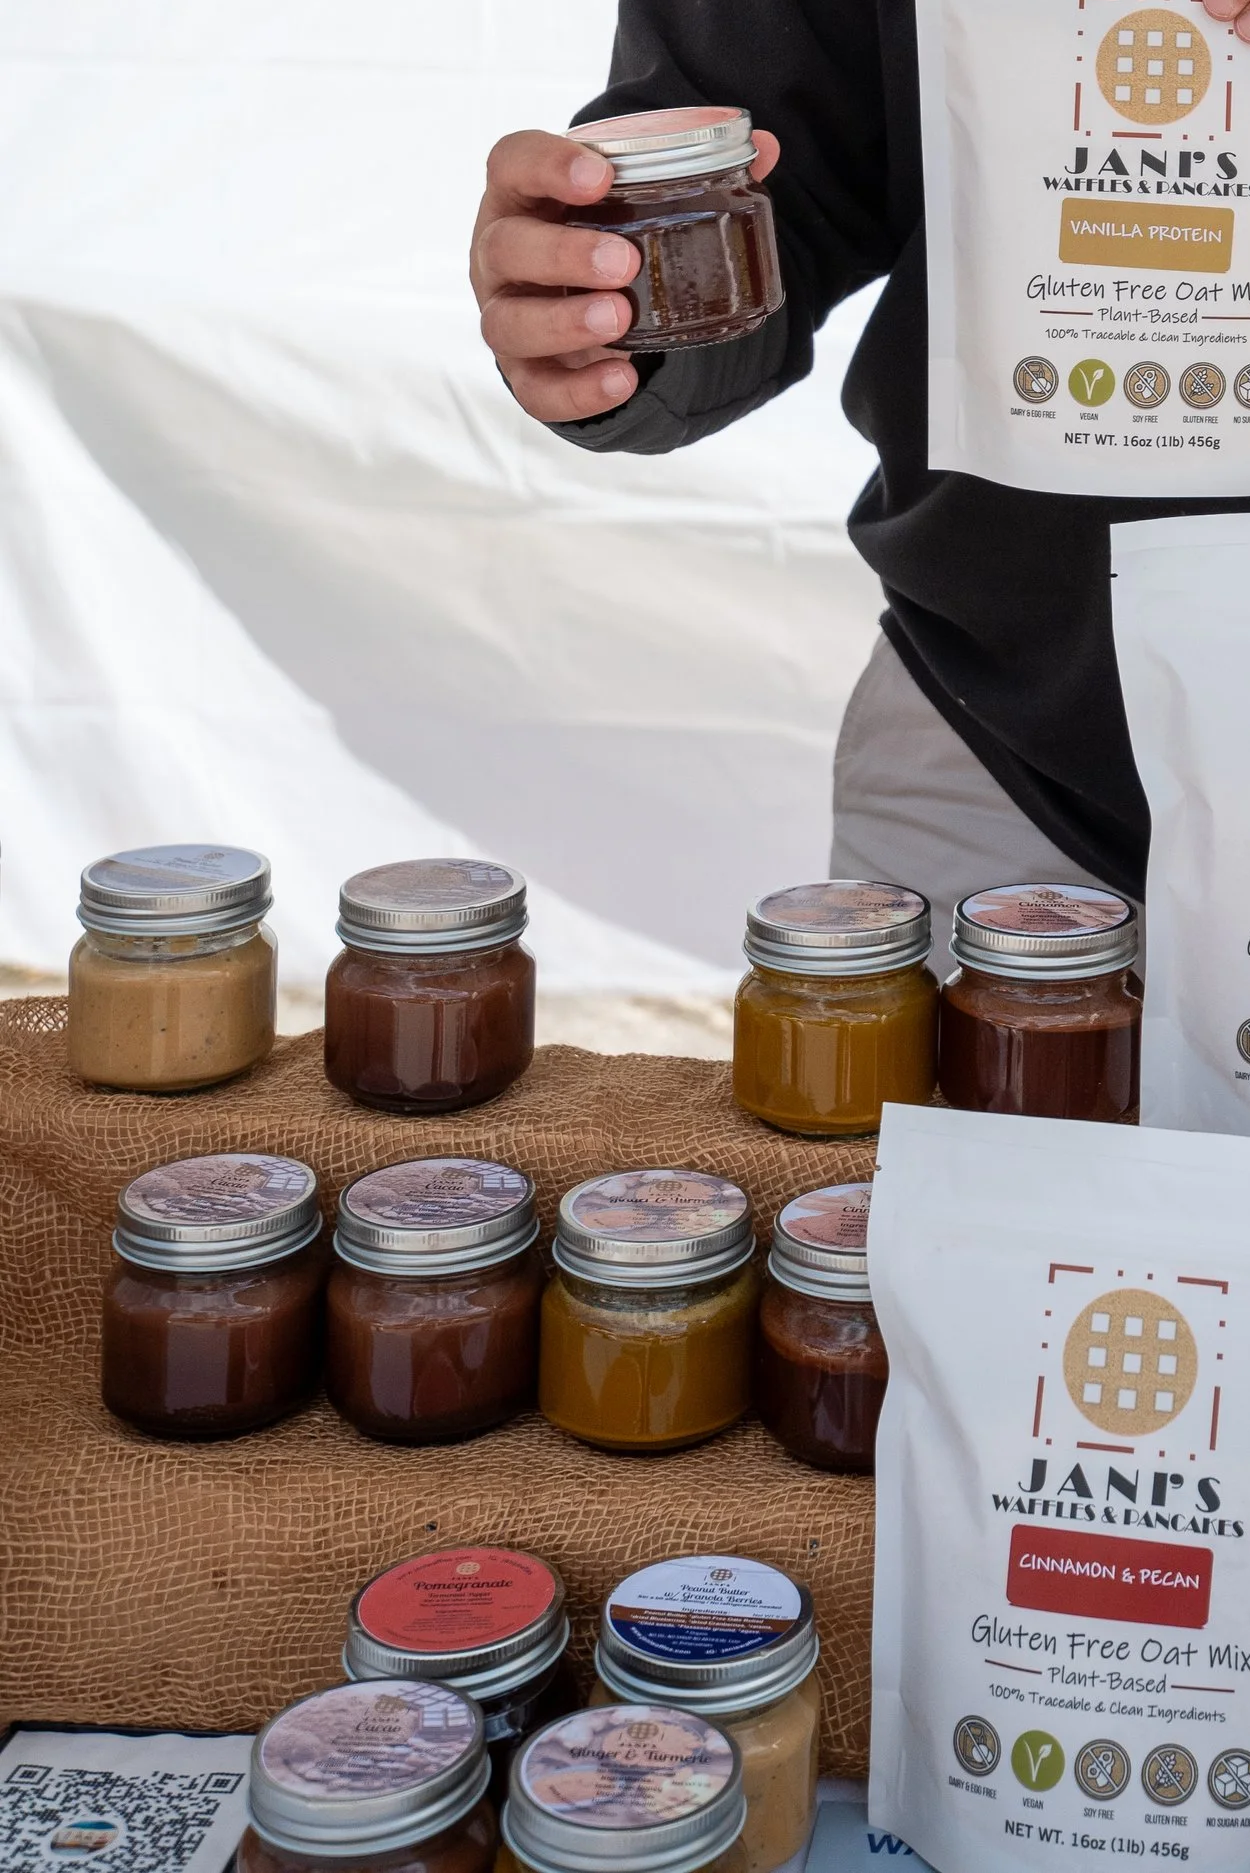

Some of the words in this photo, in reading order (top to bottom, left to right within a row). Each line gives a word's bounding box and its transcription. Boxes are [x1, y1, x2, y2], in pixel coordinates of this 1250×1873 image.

[1064, 147, 1238, 180] JANI'S
[1043, 176, 1132, 194] WAFFLES
[1138, 180, 1152, 195] &
[1070, 219, 1143, 238] VANILLA
[1148, 224, 1222, 243] PROTEIN
[1026, 275, 1105, 300] Gluten
[1113, 280, 1167, 302] Free
[1176, 282, 1223, 302] Oat
[1098, 306, 1198, 324] Plant-Based
[1045, 329, 1078, 340] 100%
[1082, 329, 1135, 342] Traceable
[1139, 331, 1148, 342] &
[1151, 332, 1179, 343] Clean
[1182, 332, 1248, 346] Ingredients
[1010, 407, 1026, 417] DAIRY
[1031, 410, 1042, 419] EGG
[1042, 410, 1056, 419] FREE
[1080, 412, 1099, 421] VEGAN
[1132, 415, 1143, 423] SOY
[1143, 415, 1158, 423] FREE
[1182, 415, 1203, 424] GLUTEN
[1203, 416, 1219, 424] FREE
[1233, 416, 1241, 424] NO
[1064, 431, 1091, 446] NET
[1094, 432, 1118, 447] WT.
[1122, 435, 1152, 449] 16oz
[1155, 435, 1185, 450] (1lb)
[1188, 435, 1221, 450] 456g
[1235, 1070, 1250, 1081] DAIRY
[425, 1182, 464, 1191] Cacao
[1018, 1458, 1221, 1513] JANI'S
[992, 1494, 1096, 1521] WAFFLES
[1100, 1506, 1117, 1524] &
[1124, 1509, 1244, 1537] PANCAKES
[1019, 1553, 1116, 1580] CINNAMON
[1122, 1568, 1136, 1583] &
[1140, 1569, 1200, 1588] PECAN
[413, 1580, 513, 1591] Pomegranate
[680, 1583, 716, 1594] Peanut
[718, 1586, 750, 1597] Butter
[682, 1592, 728, 1602] Granola
[727, 1595, 763, 1605] Berries
[971, 1614, 1057, 1655] Gluten
[1066, 1632, 1130, 1660] Free
[1141, 1639, 1198, 1667] Oat
[1047, 1666, 1167, 1693] Plant-Based
[989, 1683, 1025, 1702] 100%
[1028, 1691, 1091, 1712] Traceable
[1094, 1701, 1106, 1713] &
[1109, 1702, 1143, 1716] Clean
[1147, 1704, 1226, 1723] Ingredients
[355, 1721, 402, 1733] Cacao
[569, 1746, 619, 1759] Ginger
[643, 1750, 712, 1764] Turmeric
[948, 1776, 964, 1790] DAIRY
[970, 1783, 982, 1794] EGG
[983, 1786, 997, 1799] FREE
[1022, 1797, 1044, 1810] VEGAN
[1083, 1807, 1097, 1818] SOY
[1098, 1809, 1114, 1820] FREE
[1144, 1814, 1170, 1825] GLUTEN
[1171, 1815, 1188, 1826] FREE
[1206, 1817, 1216, 1827] NO
[1217, 1817, 1239, 1827] SUGAR
[1005, 1819, 1034, 1839] NET
[1038, 1828, 1065, 1845] WT.
[1071, 1832, 1106, 1850] 16oz
[1111, 1838, 1146, 1856] (1lb)
[1150, 1843, 1190, 1860] 456g
